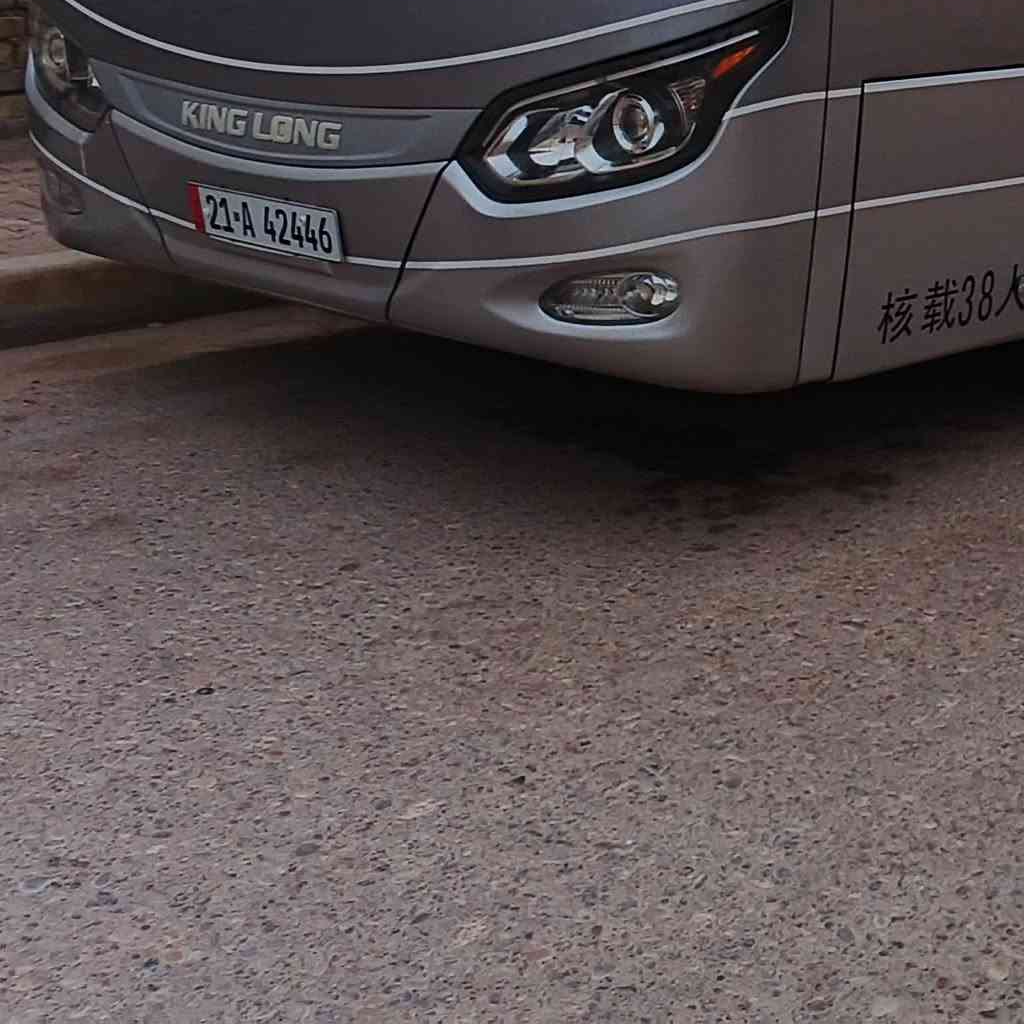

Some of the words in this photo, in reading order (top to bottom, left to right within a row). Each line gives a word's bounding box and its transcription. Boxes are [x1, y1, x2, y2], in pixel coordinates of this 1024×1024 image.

[181, 100, 249, 137] KING
[252, 112, 343, 151] LONG
[263, 206, 333, 254] 42446
